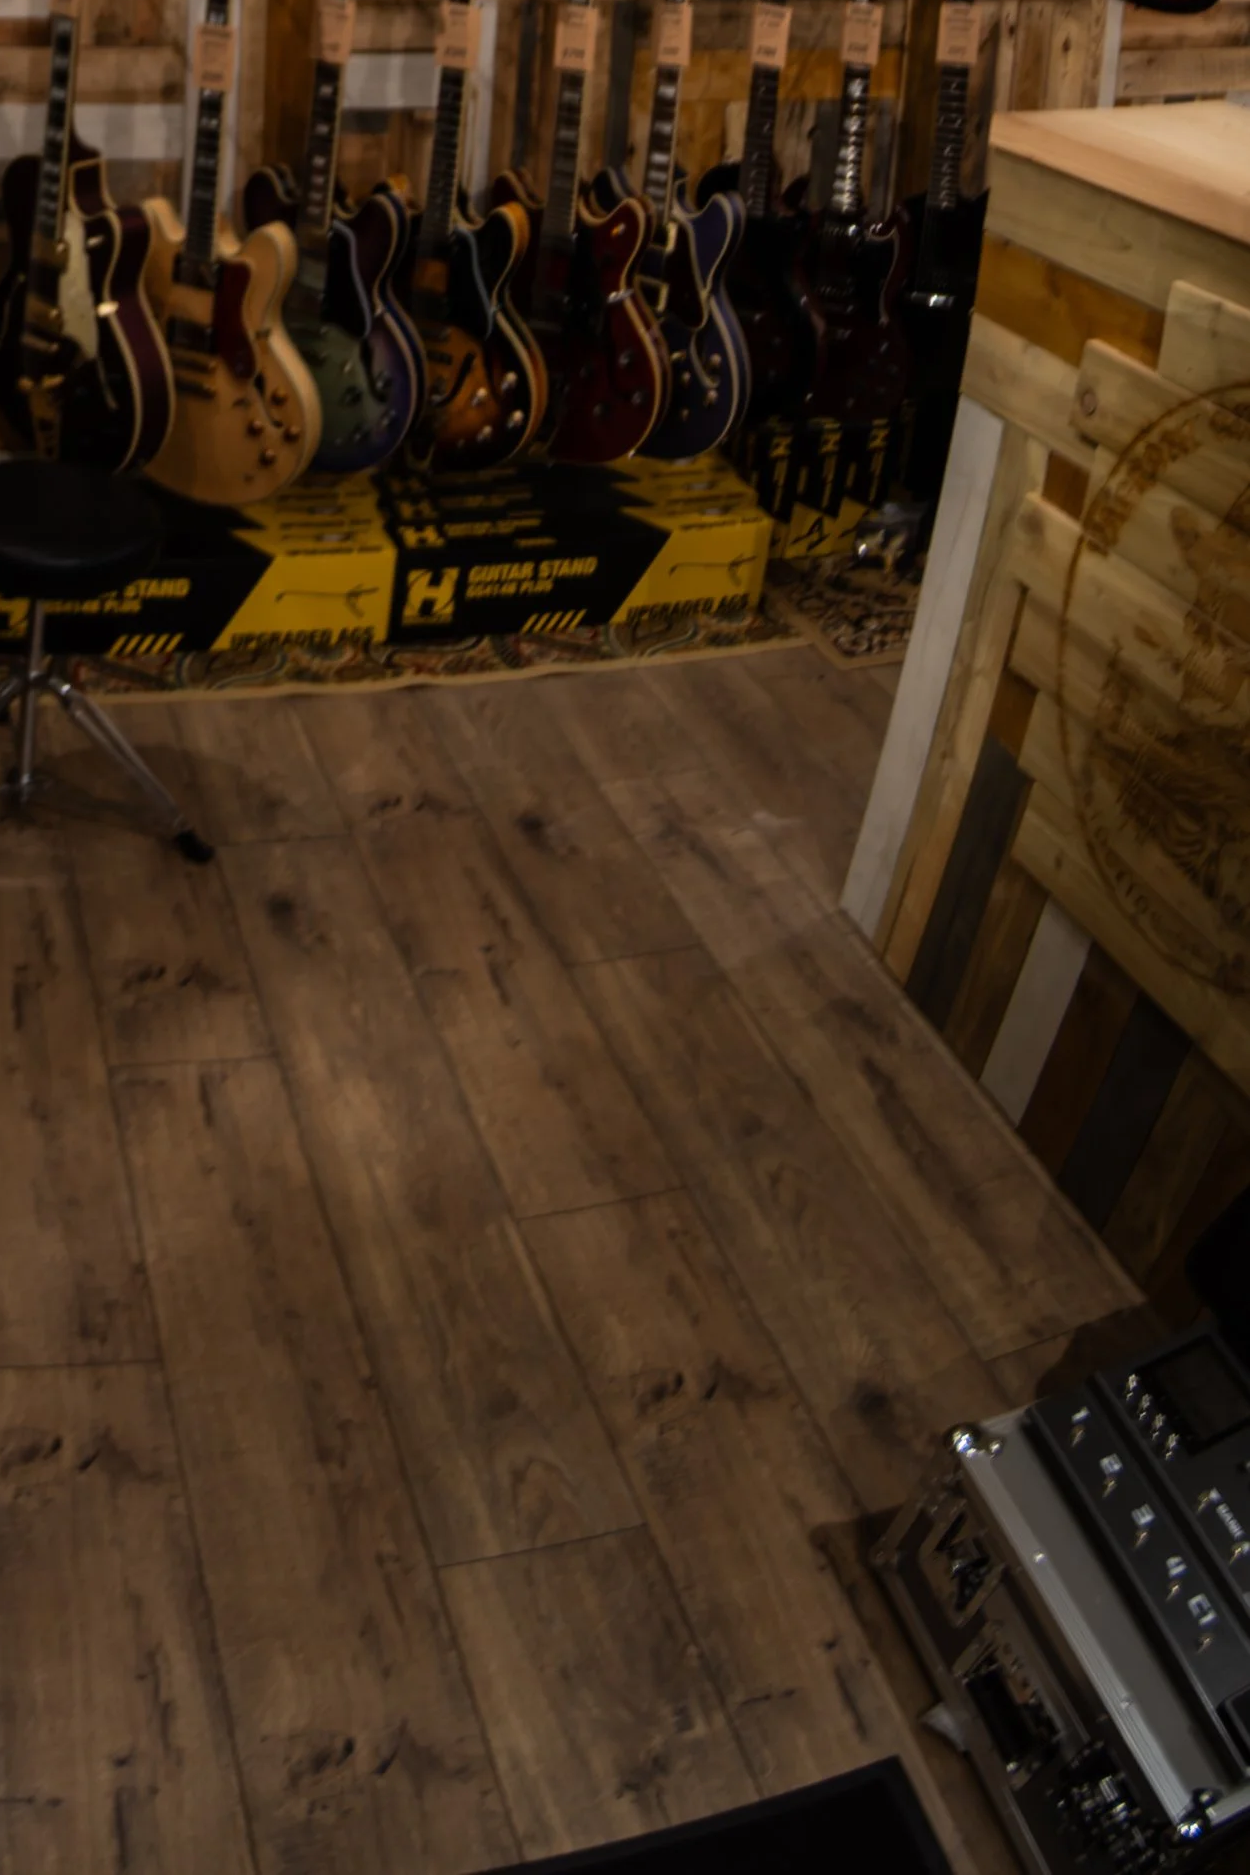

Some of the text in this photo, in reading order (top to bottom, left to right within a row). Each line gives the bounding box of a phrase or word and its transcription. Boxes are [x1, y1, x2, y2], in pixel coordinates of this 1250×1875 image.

[466, 554, 600, 582] GUITAR STAND
[625, 596, 715, 622] UPGRADED
[231, 626, 334, 650] UPGRADED
[1070, 1405, 1091, 1424] 1
[1098, 1452, 1124, 1476] 2
[1130, 1502, 1157, 1527] 3
[1165, 1555, 1189, 1578] 4
